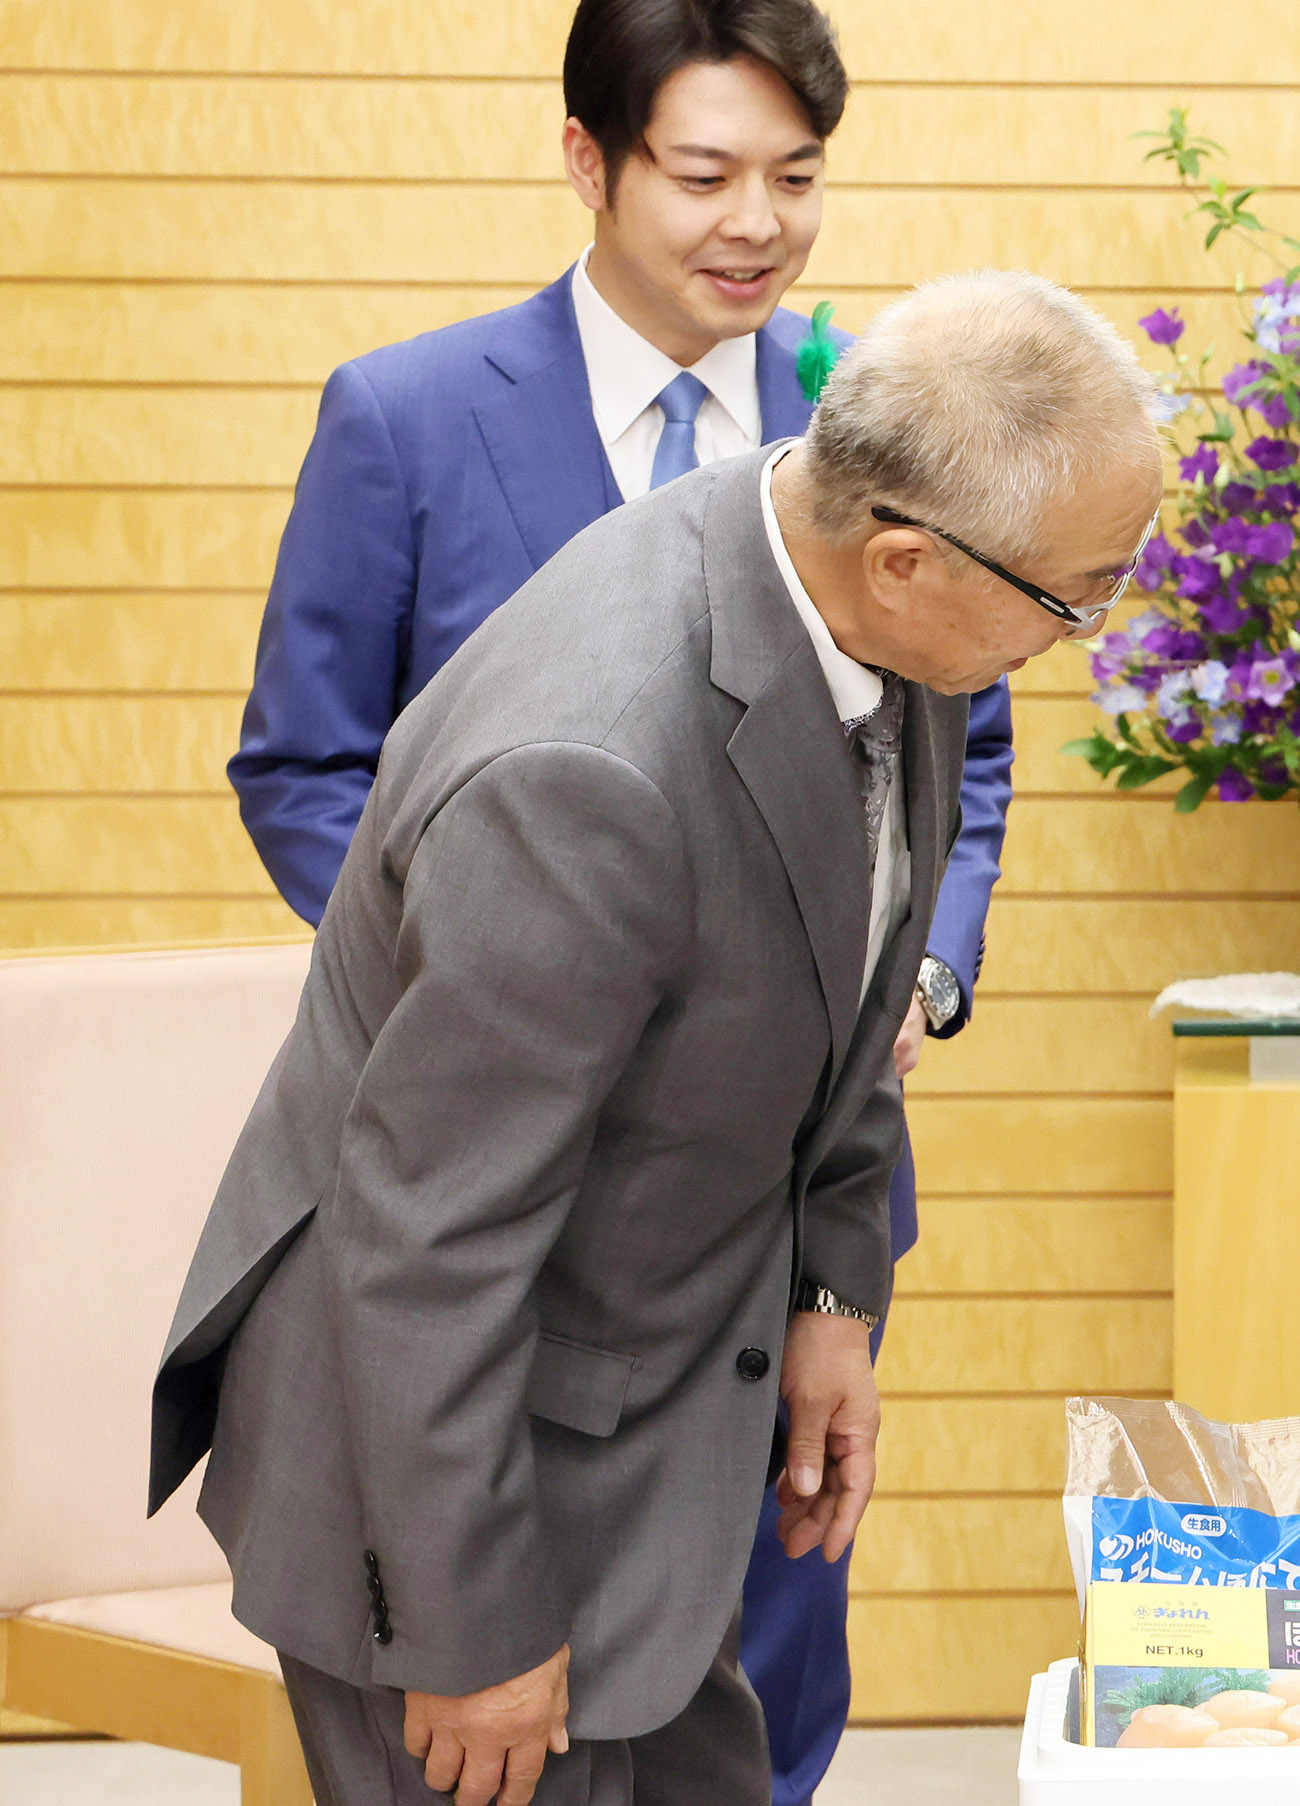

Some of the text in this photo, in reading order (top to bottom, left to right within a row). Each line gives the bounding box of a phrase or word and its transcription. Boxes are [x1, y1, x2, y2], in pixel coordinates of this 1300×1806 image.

[1187, 1517, 1222, 1532] 生食用
[1135, 1528, 1203, 1560] HOKUSHO
[1153, 1607, 1210, 1620] ぎょれん
